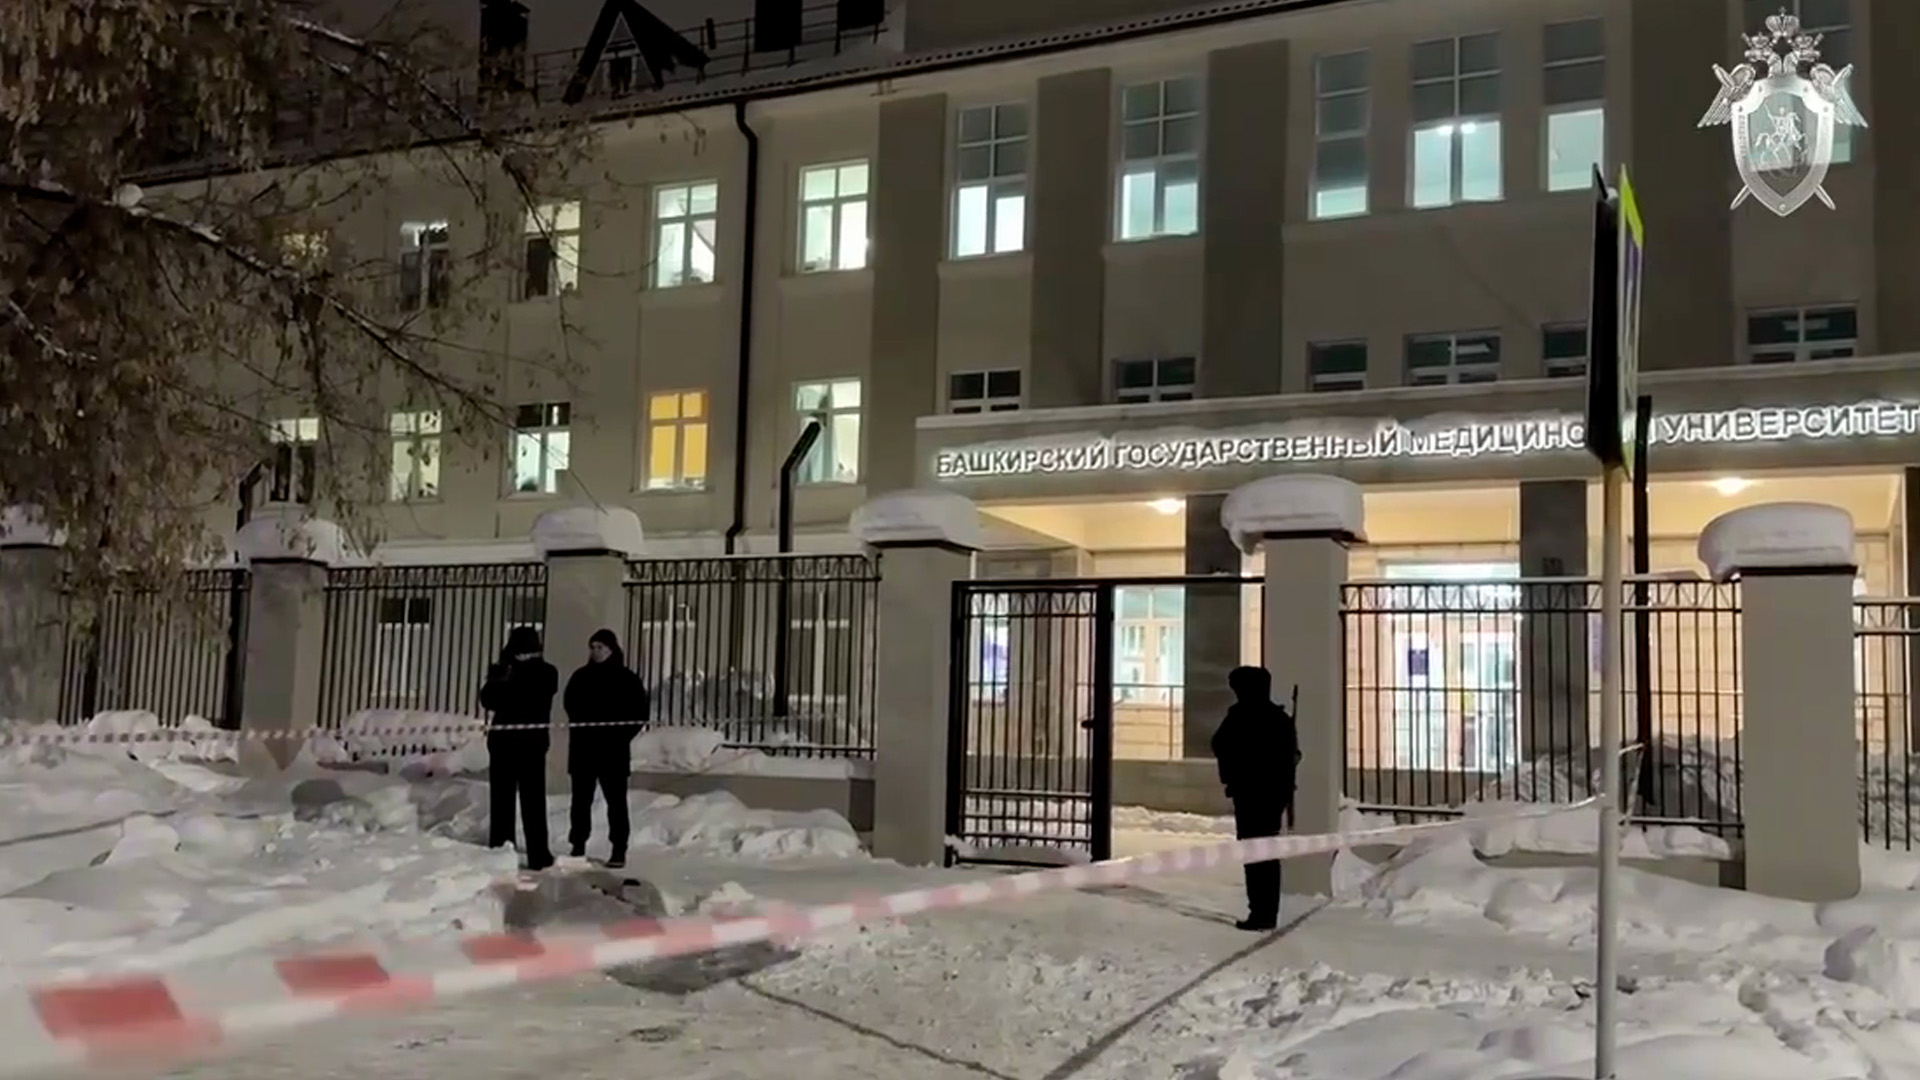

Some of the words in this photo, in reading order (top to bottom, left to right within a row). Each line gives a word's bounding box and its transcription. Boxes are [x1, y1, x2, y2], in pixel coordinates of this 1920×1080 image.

[936, 440, 1109, 477] БАШКИРСКИЙ
[1114, 422, 1402, 469] ГОСУДАРСТВЕННЫЙ
[1408, 418, 1657, 457] МЕДИЦИНС
[1662, 403, 1919, 443] УНИВЕРСИТЕТ
